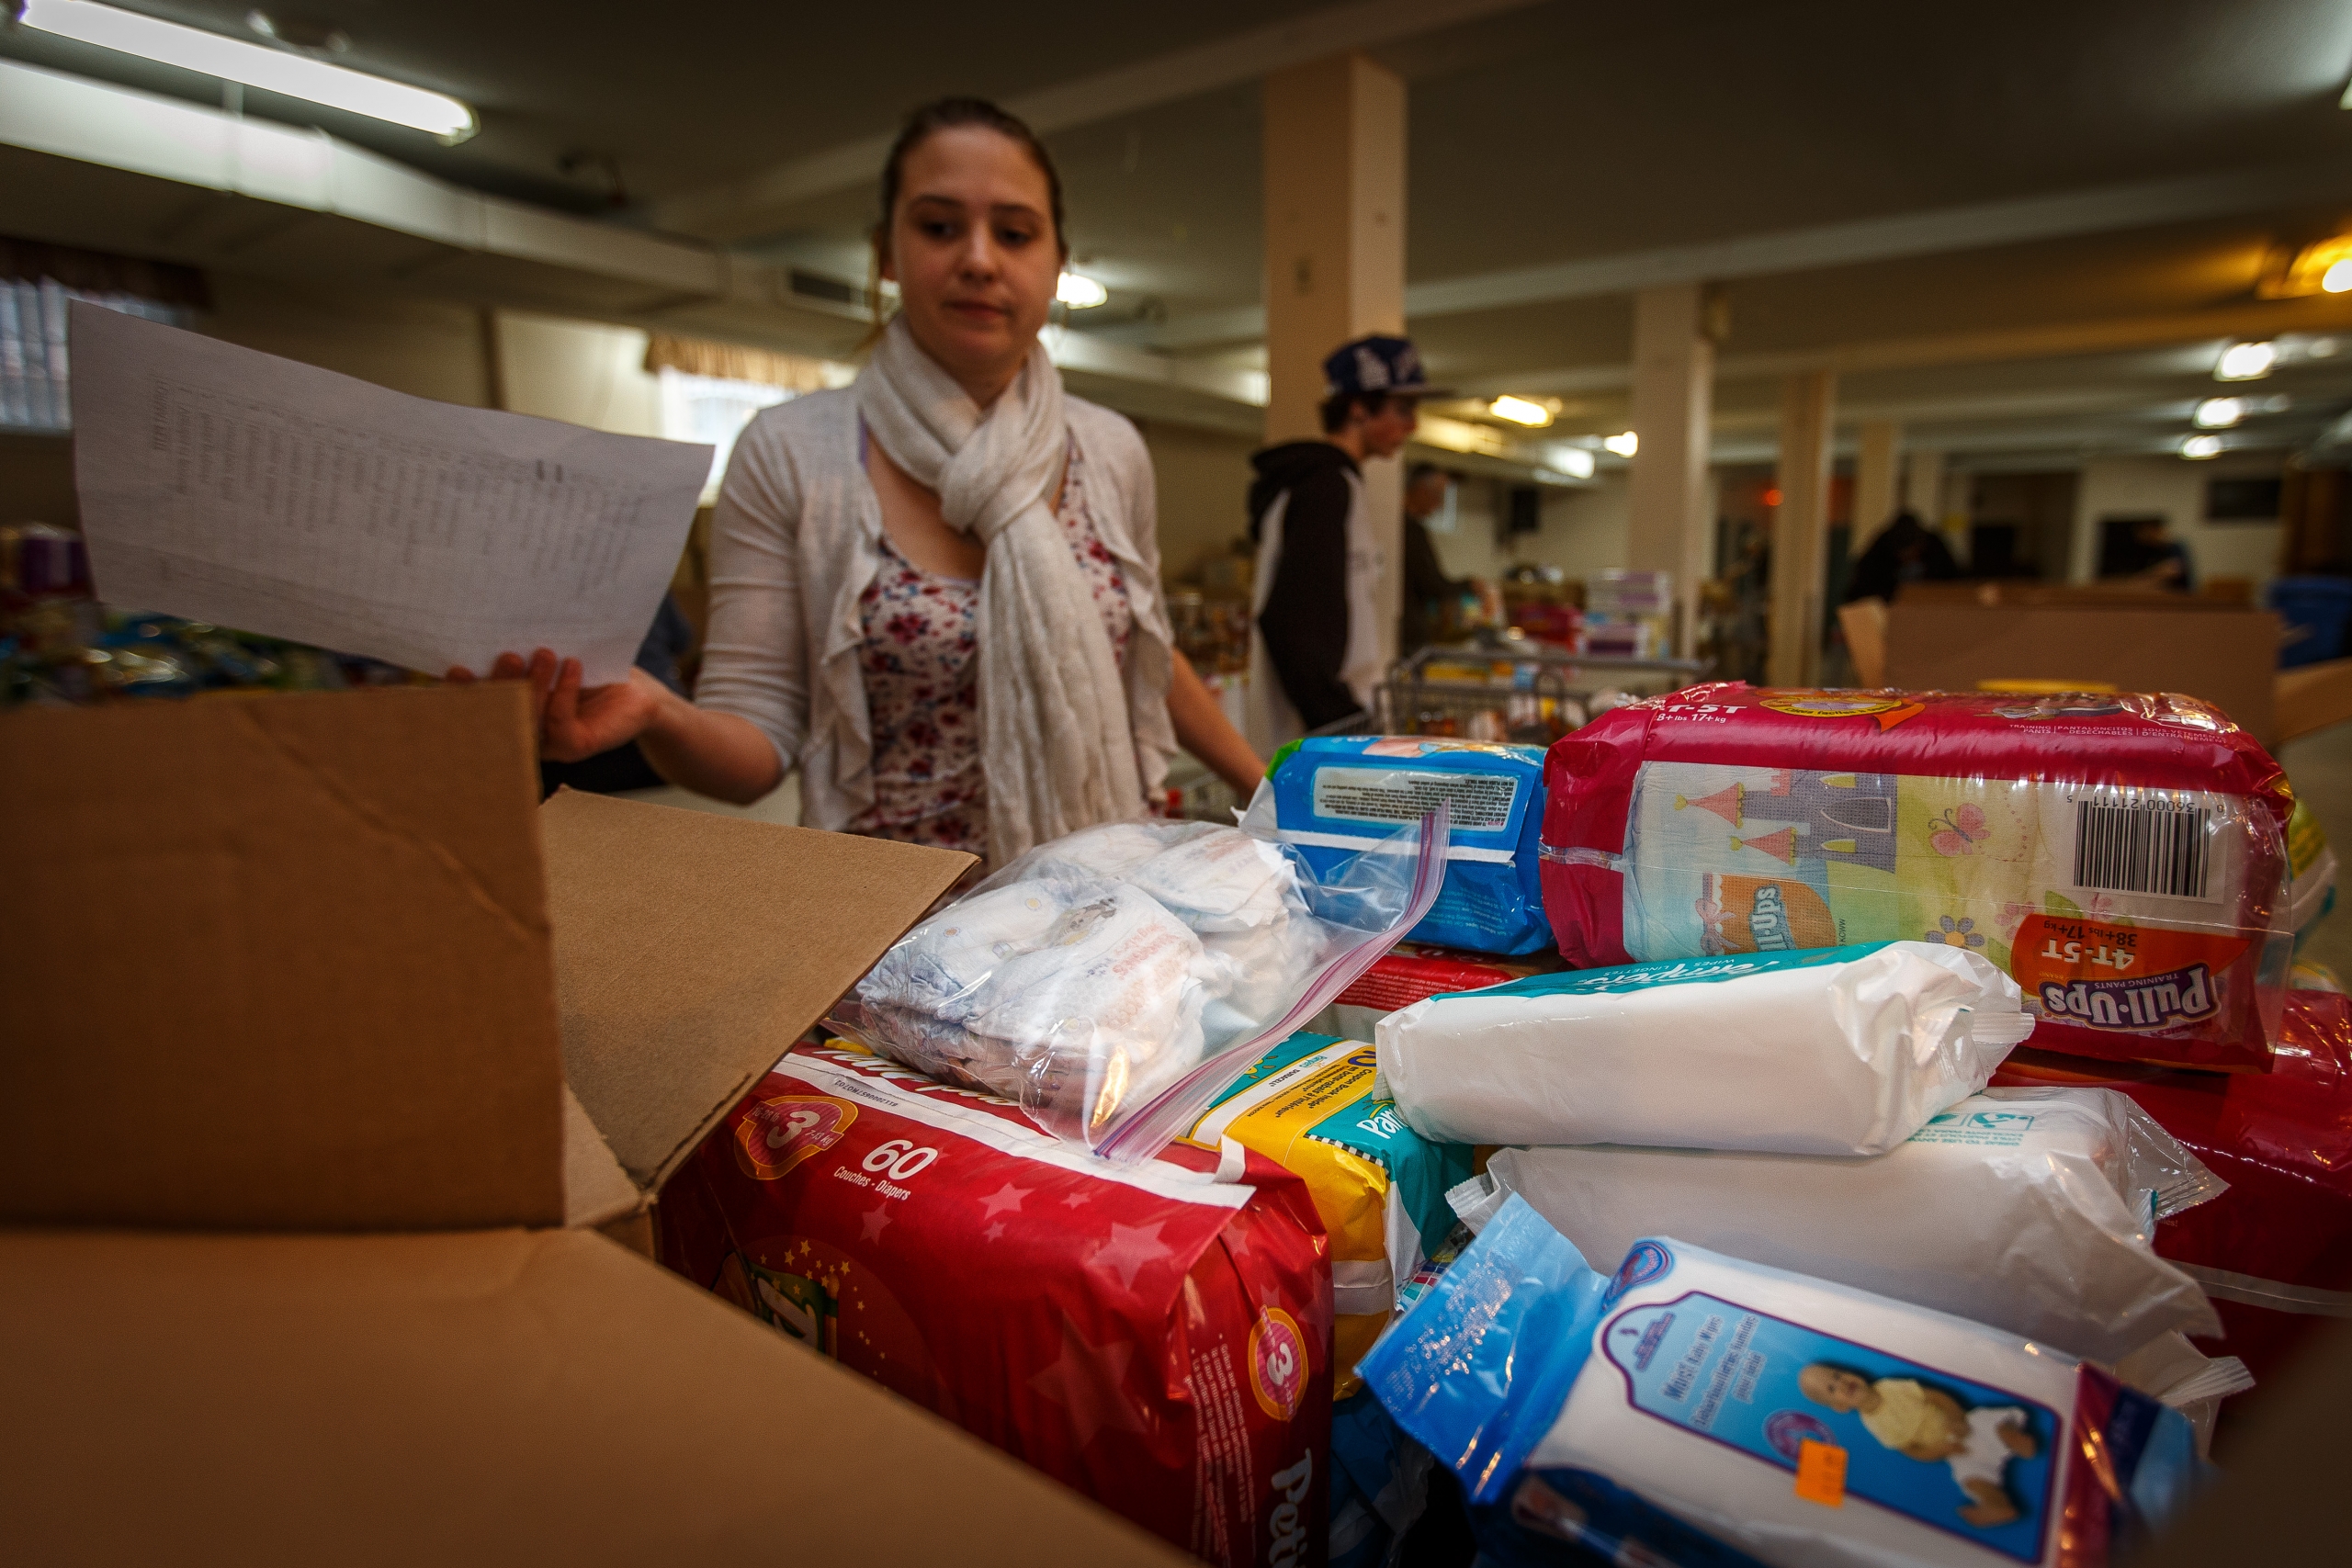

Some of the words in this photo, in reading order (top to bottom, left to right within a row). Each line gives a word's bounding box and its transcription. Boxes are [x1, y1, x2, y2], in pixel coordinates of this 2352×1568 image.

[1690, 712, 1715, 723] 17+
[2066, 795, 2073, 804] 5
[2093, 795, 2139, 809] 21111
[2146, 799, 2196, 814] 36000
[2043, 919, 2057, 931] kg
[2058, 924, 2086, 939] 17+
[2088, 927, 2104, 938] lbs
[2105, 931, 2137, 947] 38+
[2041, 939, 2135, 971] 4T-5T
[1693, 958, 1736, 967] WIPES
[1604, 964, 1670, 976] LINGETTES
[2094, 980, 2126, 989] PANTS
[2128, 973, 2179, 987] TRAINING
[766, 1110, 821, 1150] 3
[861, 1138, 939, 1180] 60
[833, 1166, 872, 1189] Couches
[875, 1176, 912, 1201] Diapers
[1266, 1344, 1294, 1386] 3
